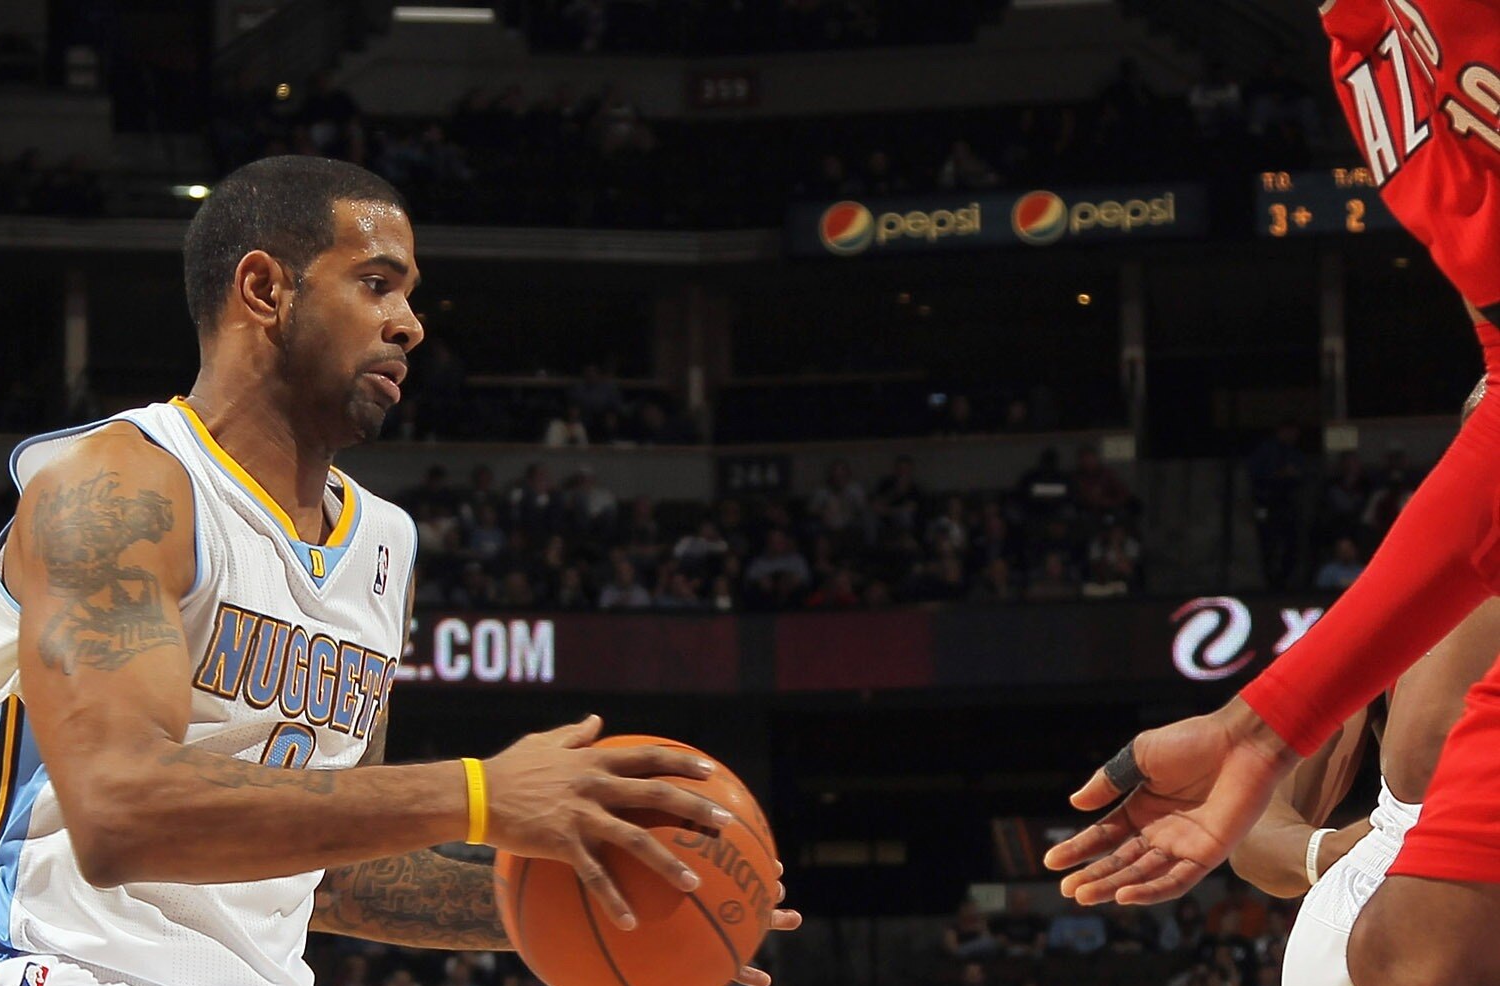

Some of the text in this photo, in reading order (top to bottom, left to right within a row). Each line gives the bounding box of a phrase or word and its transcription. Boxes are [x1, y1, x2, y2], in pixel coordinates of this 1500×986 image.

[876, 203, 980, 244] pepsi
[1070, 192, 1175, 233] pepsi
[1346, 198, 1366, 233] 2
